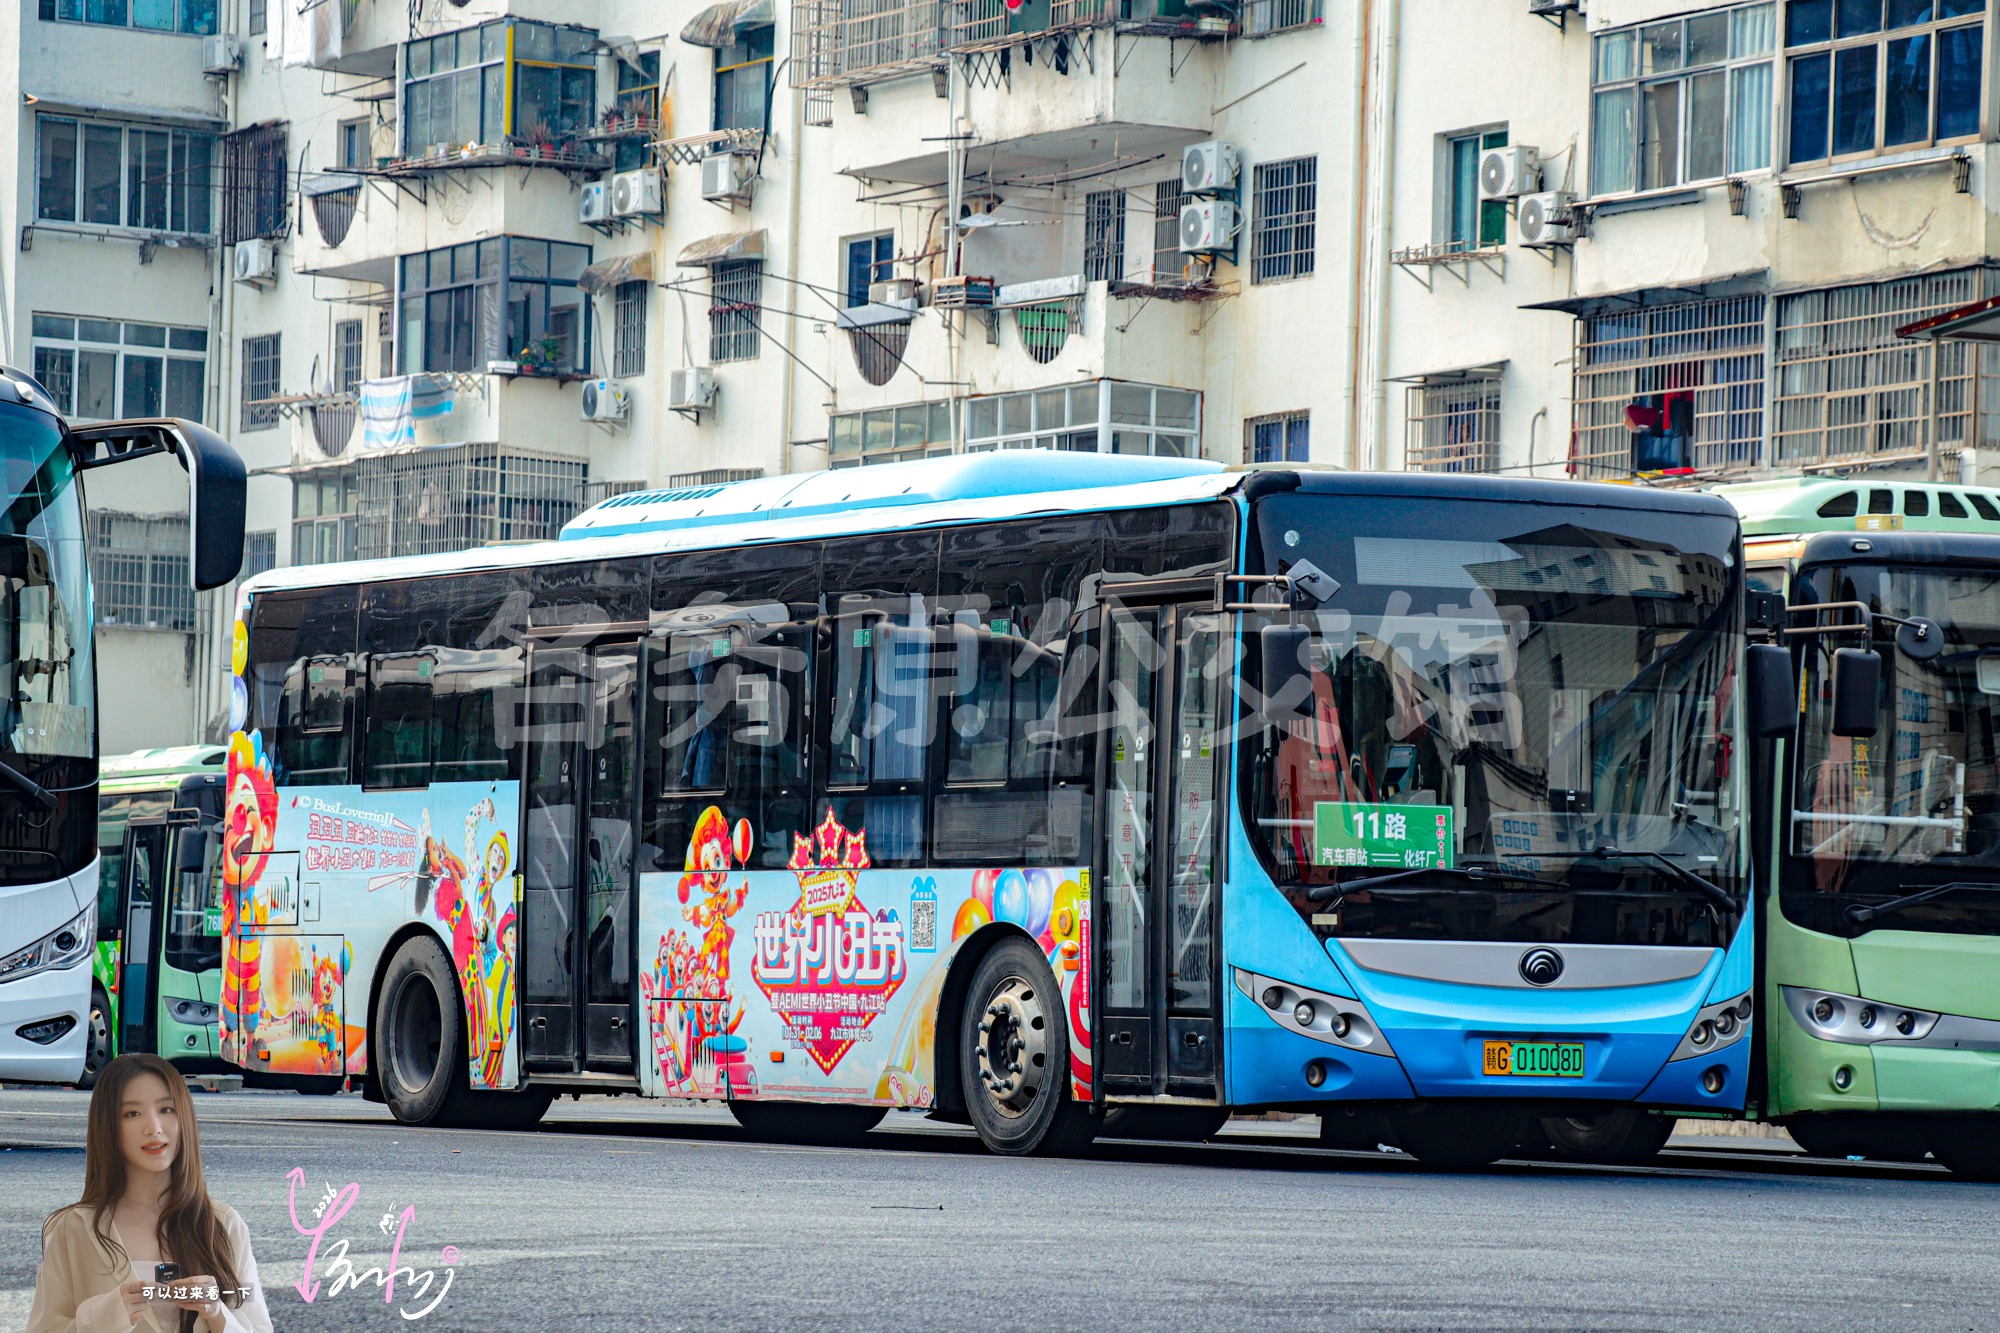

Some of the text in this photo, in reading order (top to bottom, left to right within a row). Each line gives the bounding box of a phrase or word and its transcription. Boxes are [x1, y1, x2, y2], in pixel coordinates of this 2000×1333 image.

[1353, 811, 1407, 841] 11路
[1120, 794, 1133, 903] 注意开门
[1187, 790, 1200, 902] 防止夹伤
[1322, 847, 1437, 868] 汽车南站 化纤厂
[807, 882, 846, 905] 2025九江
[754, 912, 904, 984] 世界小丑节
[830, 1026, 873, 1042] 九江市体育中心
